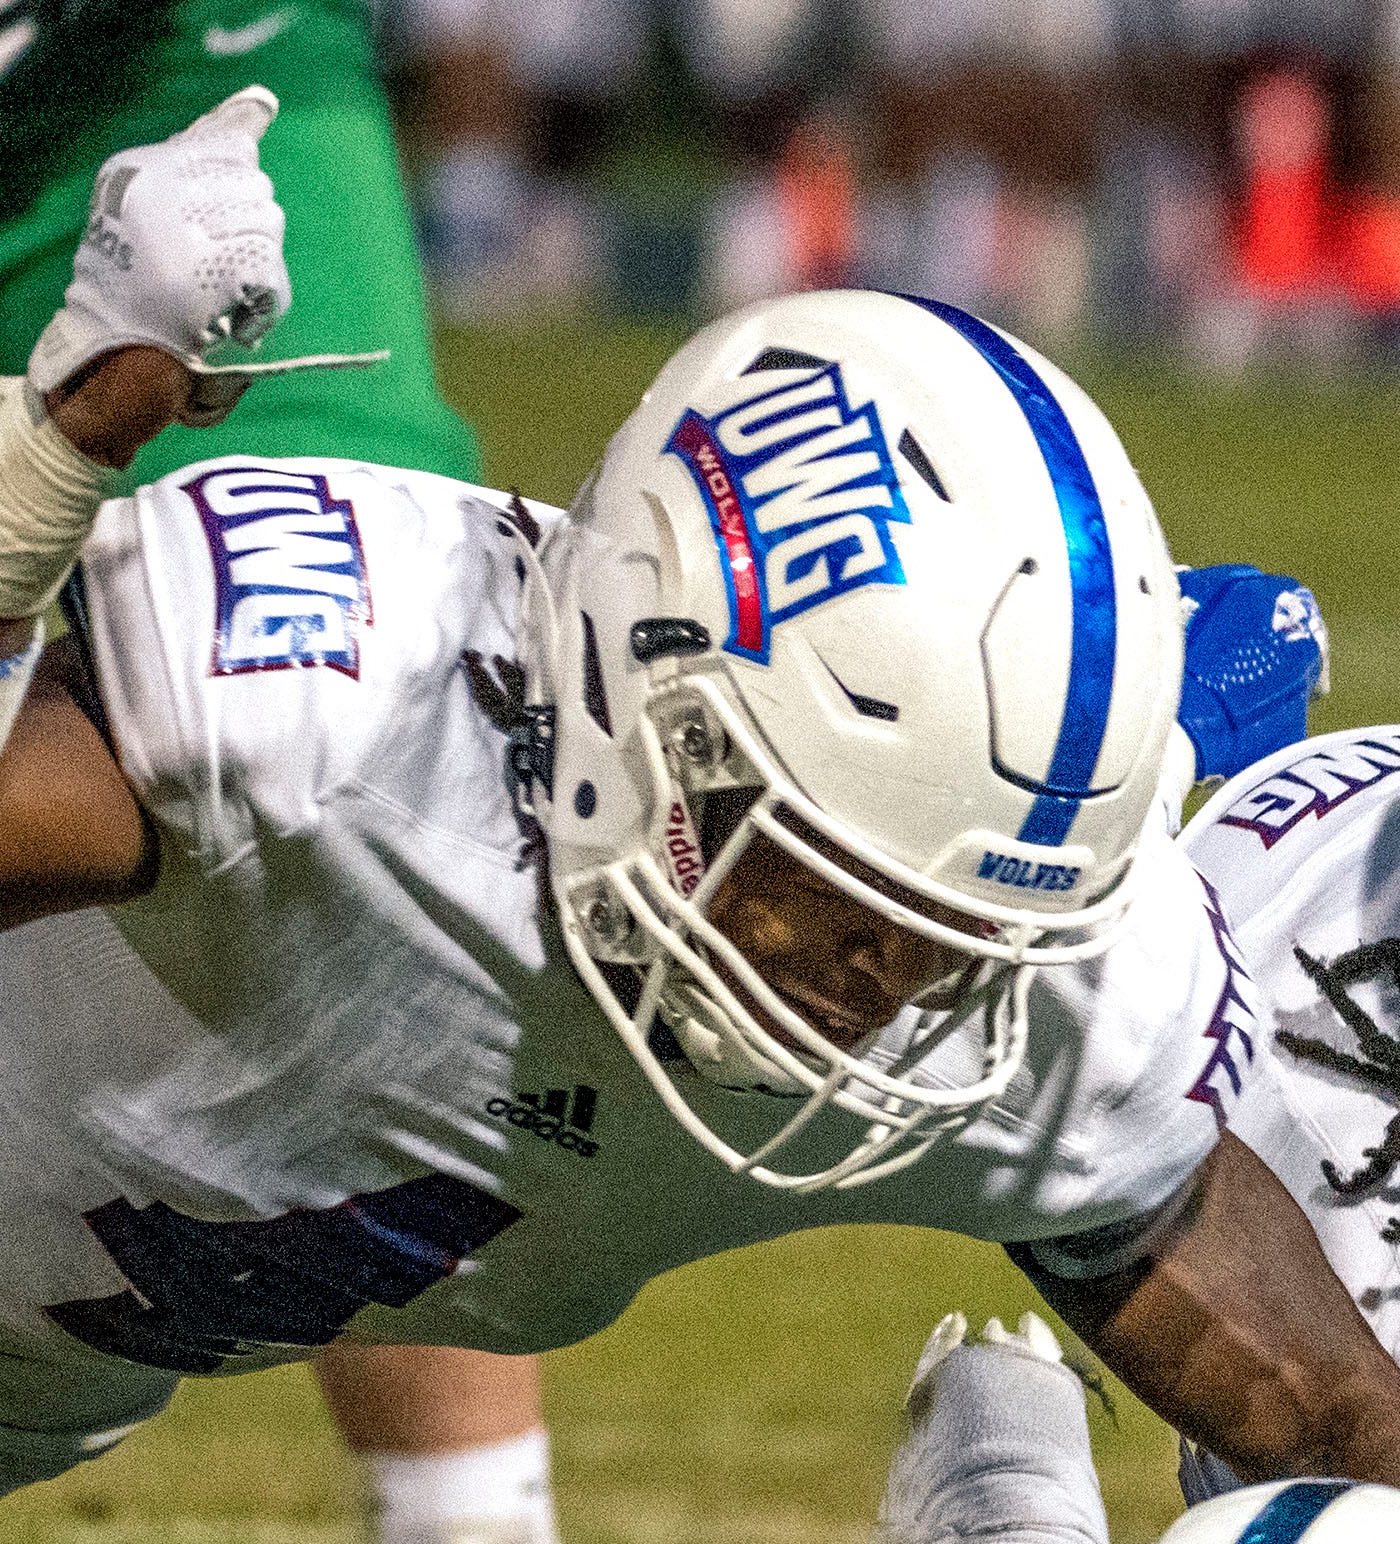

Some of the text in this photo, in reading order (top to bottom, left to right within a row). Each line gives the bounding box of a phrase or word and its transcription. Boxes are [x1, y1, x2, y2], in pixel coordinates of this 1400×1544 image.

[695, 442, 758, 600] WOLV
[708, 370, 900, 618] UWG
[192, 471, 368, 666] UWG
[665, 801, 699, 896] Ridde
[976, 850, 1082, 892] WOLVES
[486, 1097, 601, 1158] adidas
